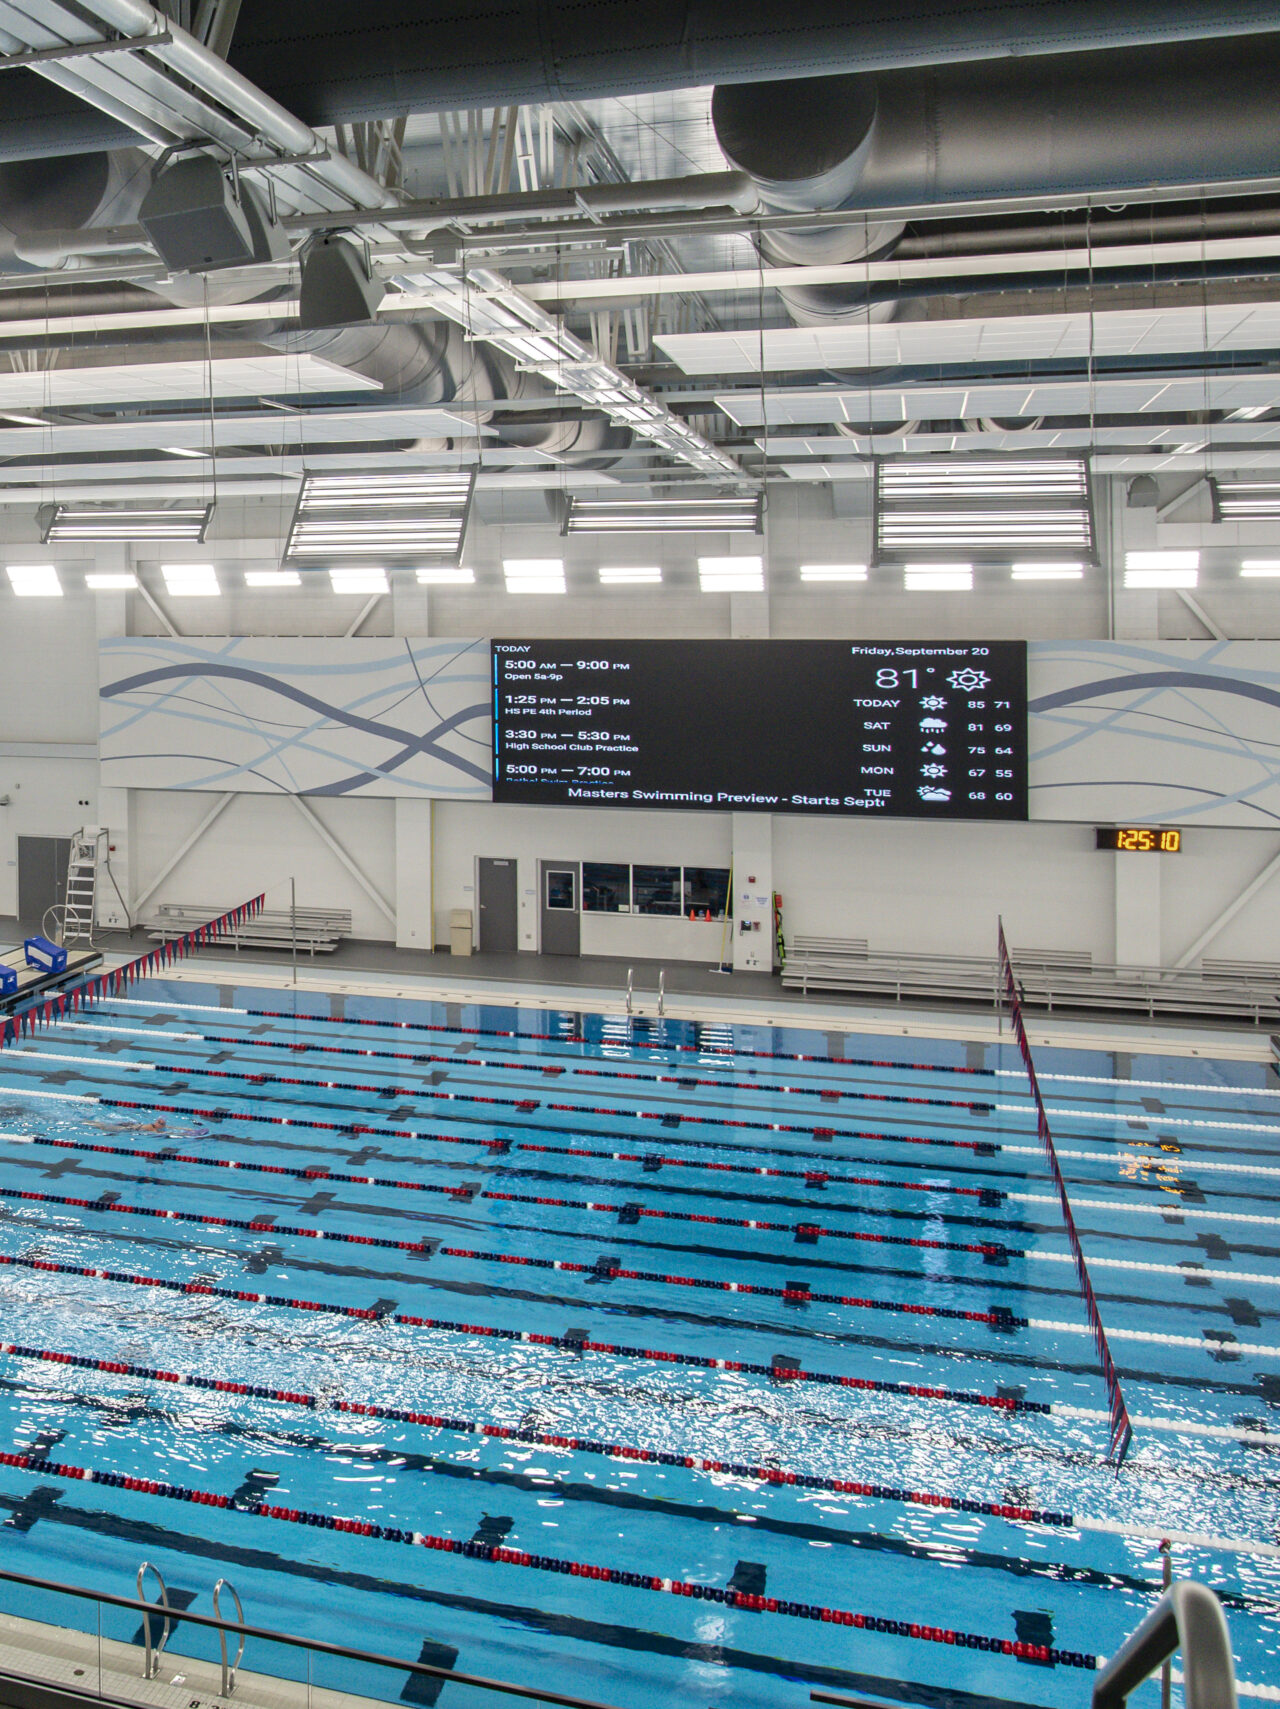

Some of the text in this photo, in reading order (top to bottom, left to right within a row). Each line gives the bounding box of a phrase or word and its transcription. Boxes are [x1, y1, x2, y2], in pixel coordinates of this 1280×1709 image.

[505, 660, 536, 669] 5:00
[576, 661, 609, 669] 9:00
[505, 695, 537, 704] 1:25
[577, 696, 609, 705] 2:05
[853, 699, 900, 707] TODAY
[968, 723, 983, 731] 81
[505, 730, 537, 738] 3:30
[578, 731, 610, 740] 5:30
[863, 744, 891, 752] SUN
[506, 765, 537, 774] 5:00
[577, 767, 610, 776] 7:00
[568, 788, 629, 798] Masters
[633, 790, 713, 802] Swimming
[717, 793, 778, 803] Preview
[792, 795, 840, 805] Starts
[864, 789, 891, 797] TUE
[969, 792, 986, 800] 68
[1118, 830, 1180, 851] 1:25:10
